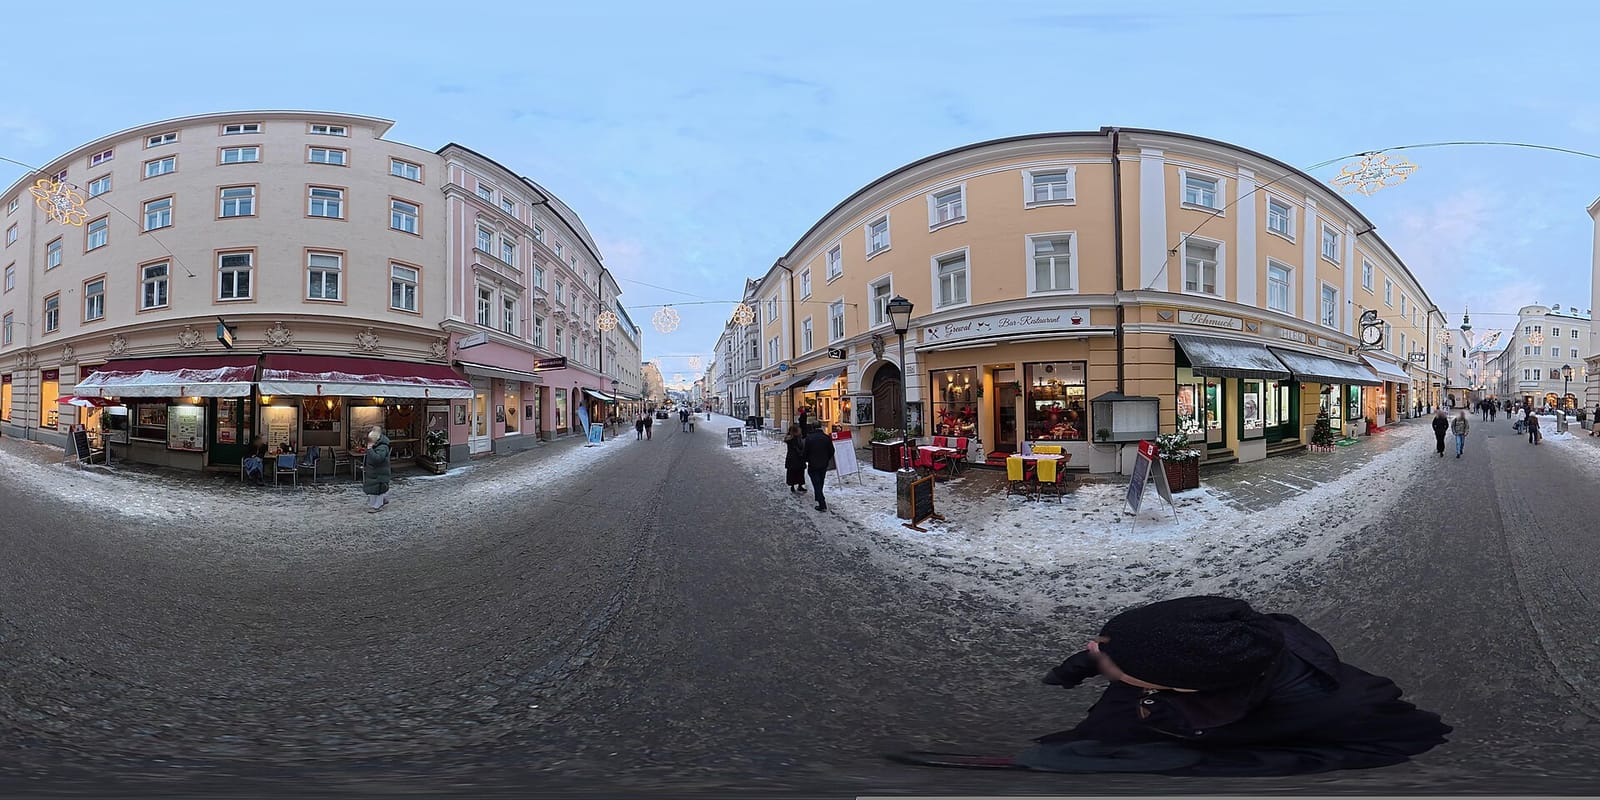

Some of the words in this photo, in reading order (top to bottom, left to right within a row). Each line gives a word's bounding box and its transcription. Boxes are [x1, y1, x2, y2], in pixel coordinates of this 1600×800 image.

[944, 322, 972, 337] Grewal
[998, 315, 1060, 328] Bar-Restaurant
[1190, 312, 1234, 328] Schmuck
